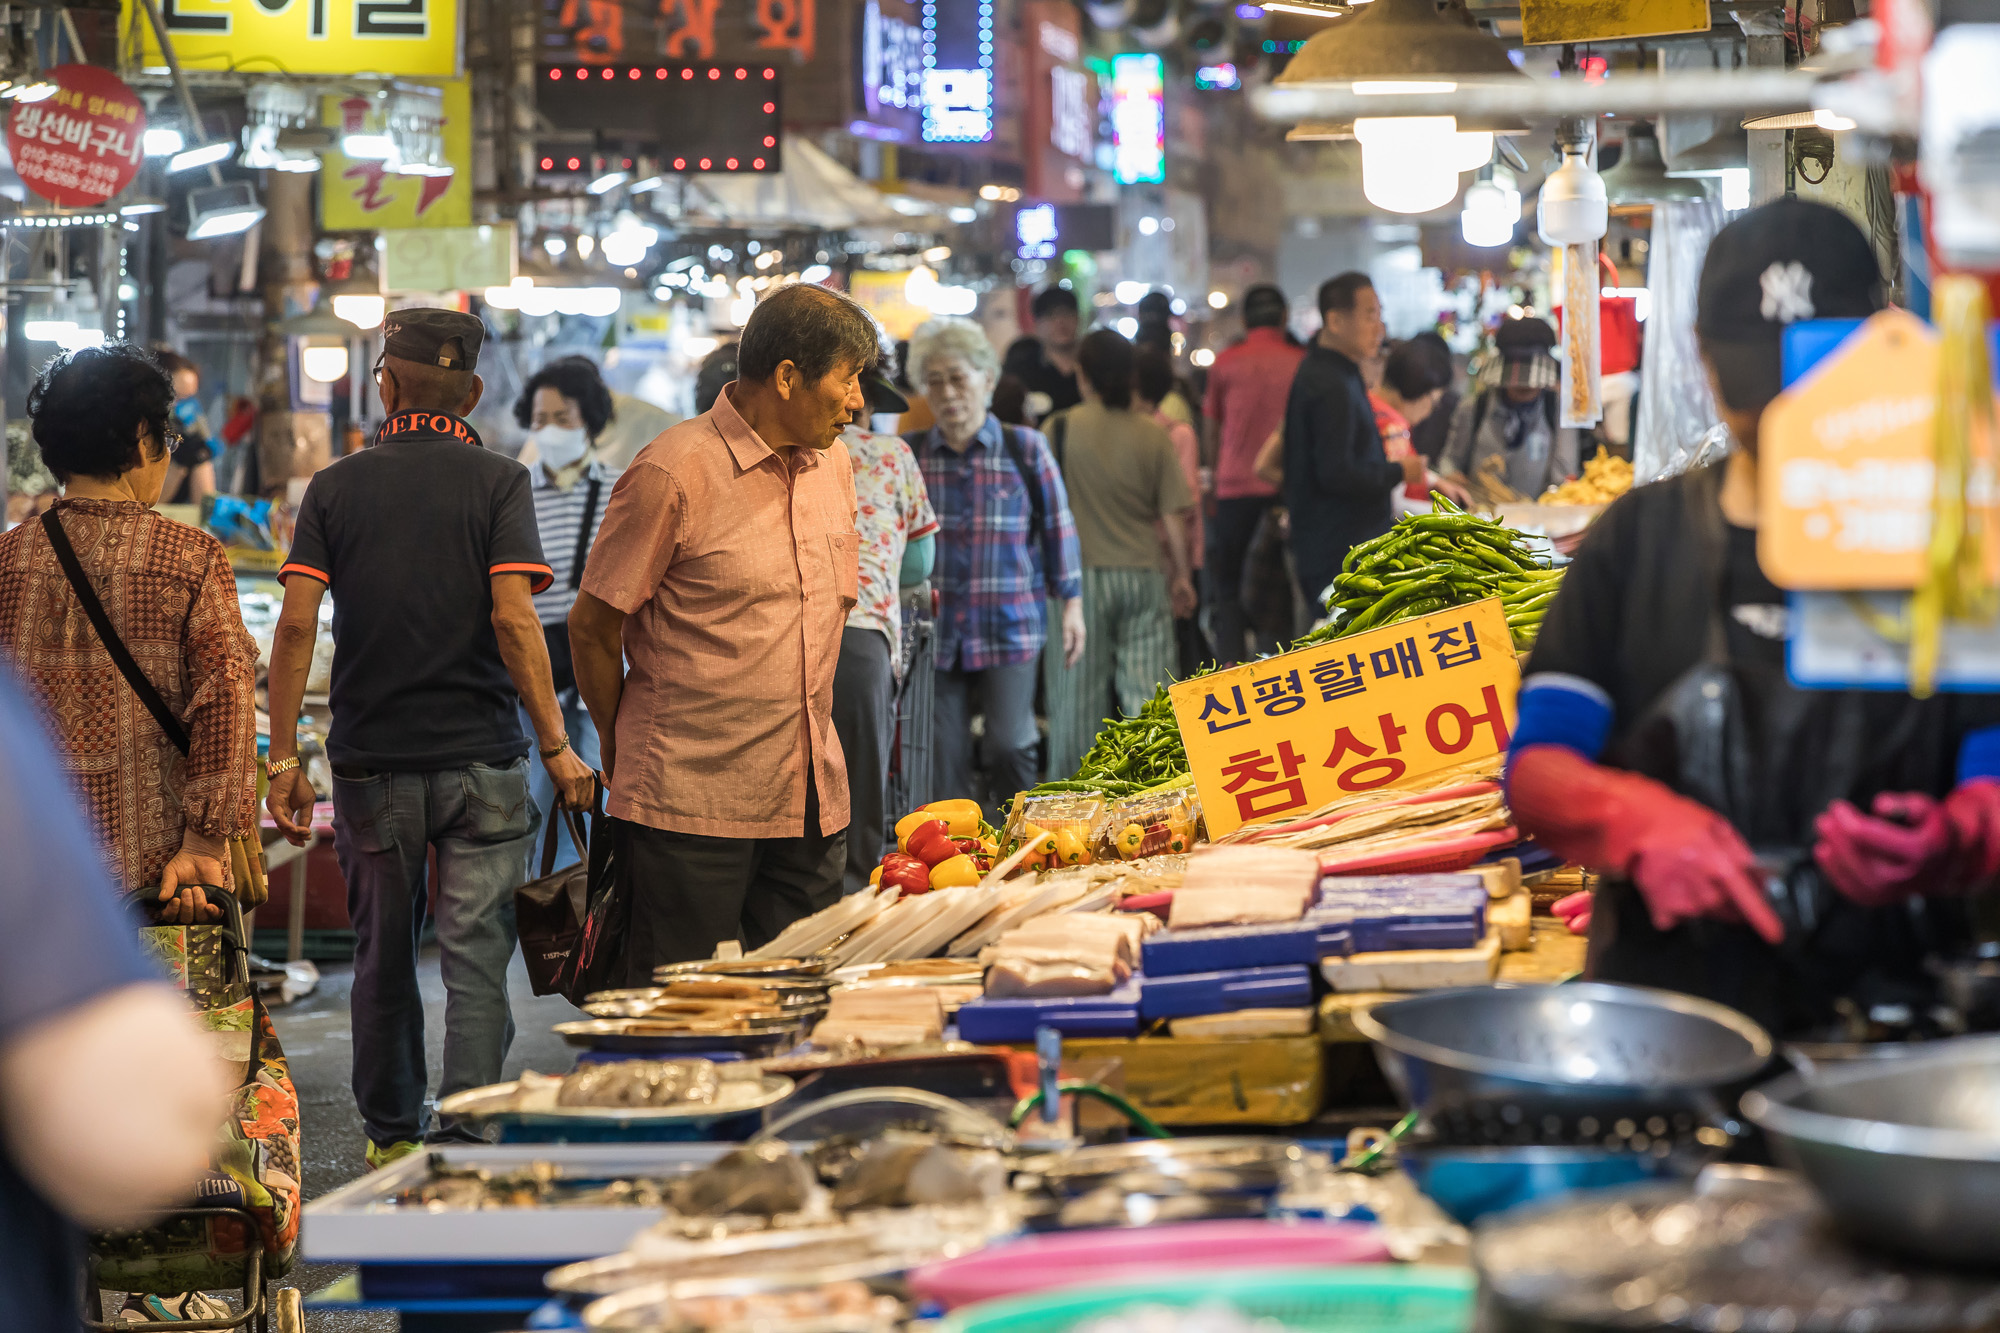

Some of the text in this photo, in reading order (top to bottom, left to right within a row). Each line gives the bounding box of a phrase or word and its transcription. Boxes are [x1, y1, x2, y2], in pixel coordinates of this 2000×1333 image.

[14, 105, 141, 165] 생선바구니
[1198, 620, 1482, 734] 신평할매집
[1221, 685, 1512, 823] 참상어
